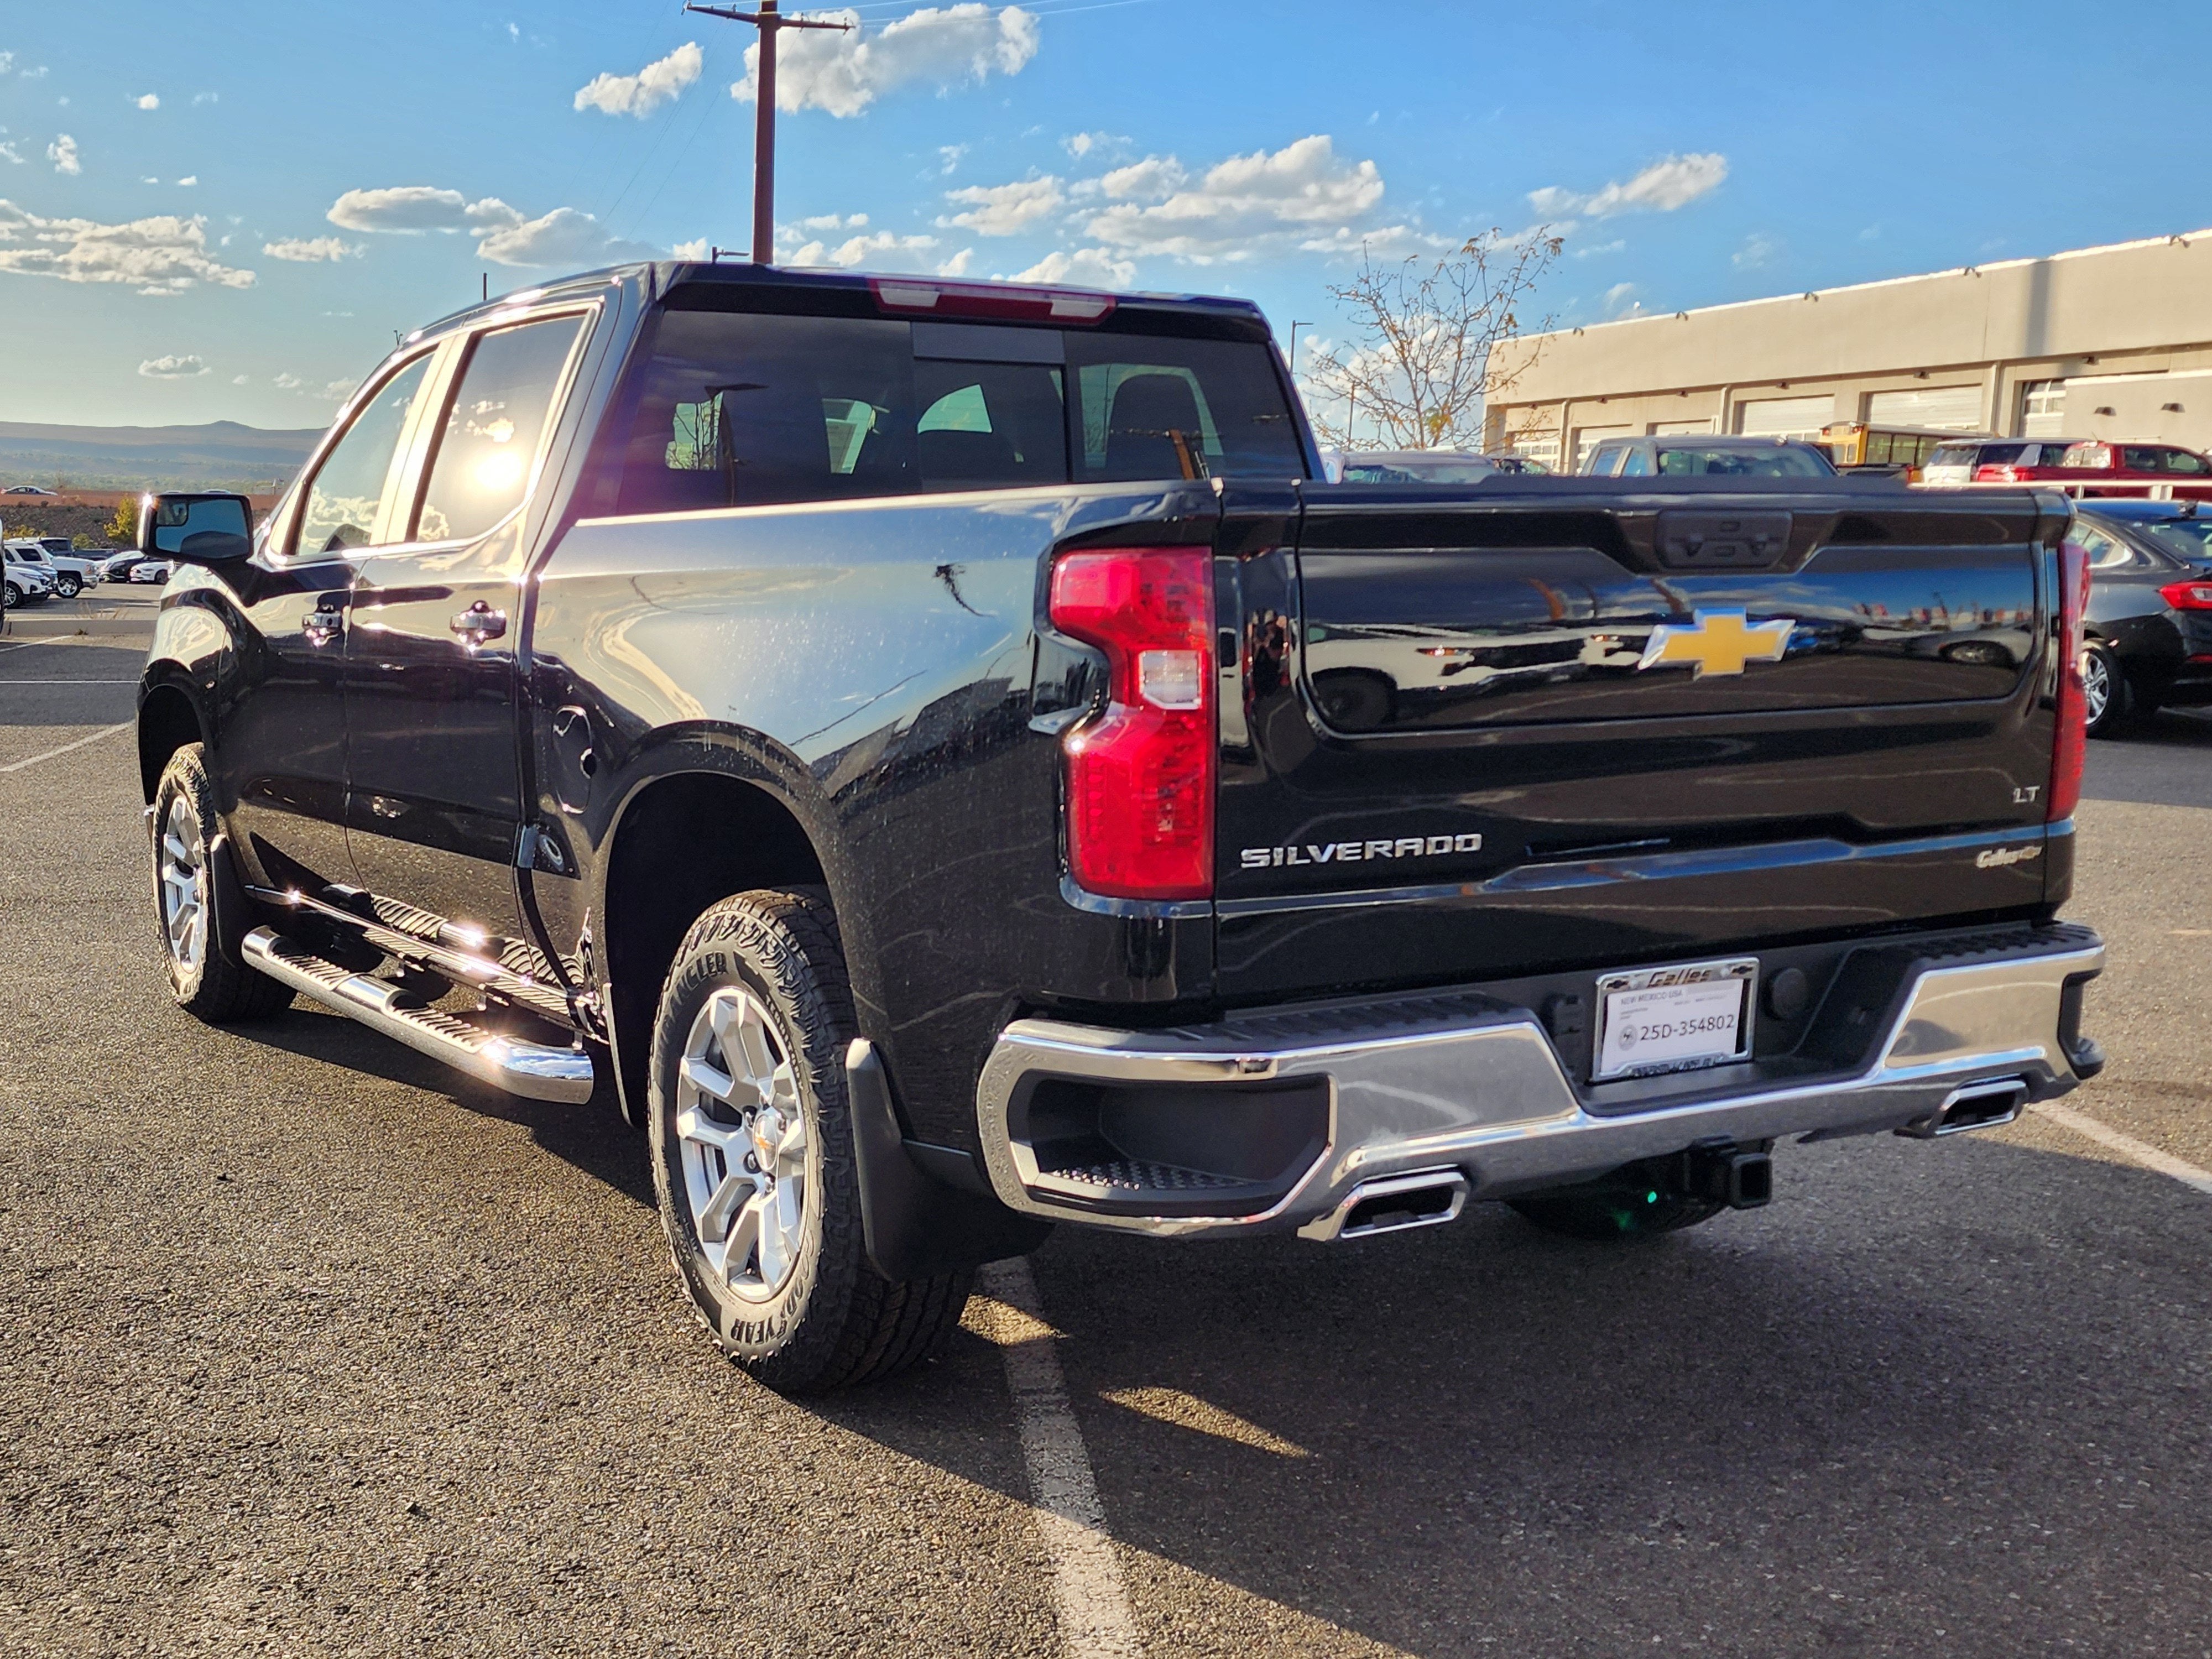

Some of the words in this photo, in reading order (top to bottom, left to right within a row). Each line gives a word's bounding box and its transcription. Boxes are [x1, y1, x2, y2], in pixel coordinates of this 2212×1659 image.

[2013, 785, 2041, 803] LT
[1241, 833, 1483, 869] SILVERADO
[1646, 968, 1713, 989] Galles
[1640, 1014, 1735, 1041] 25D-354802
